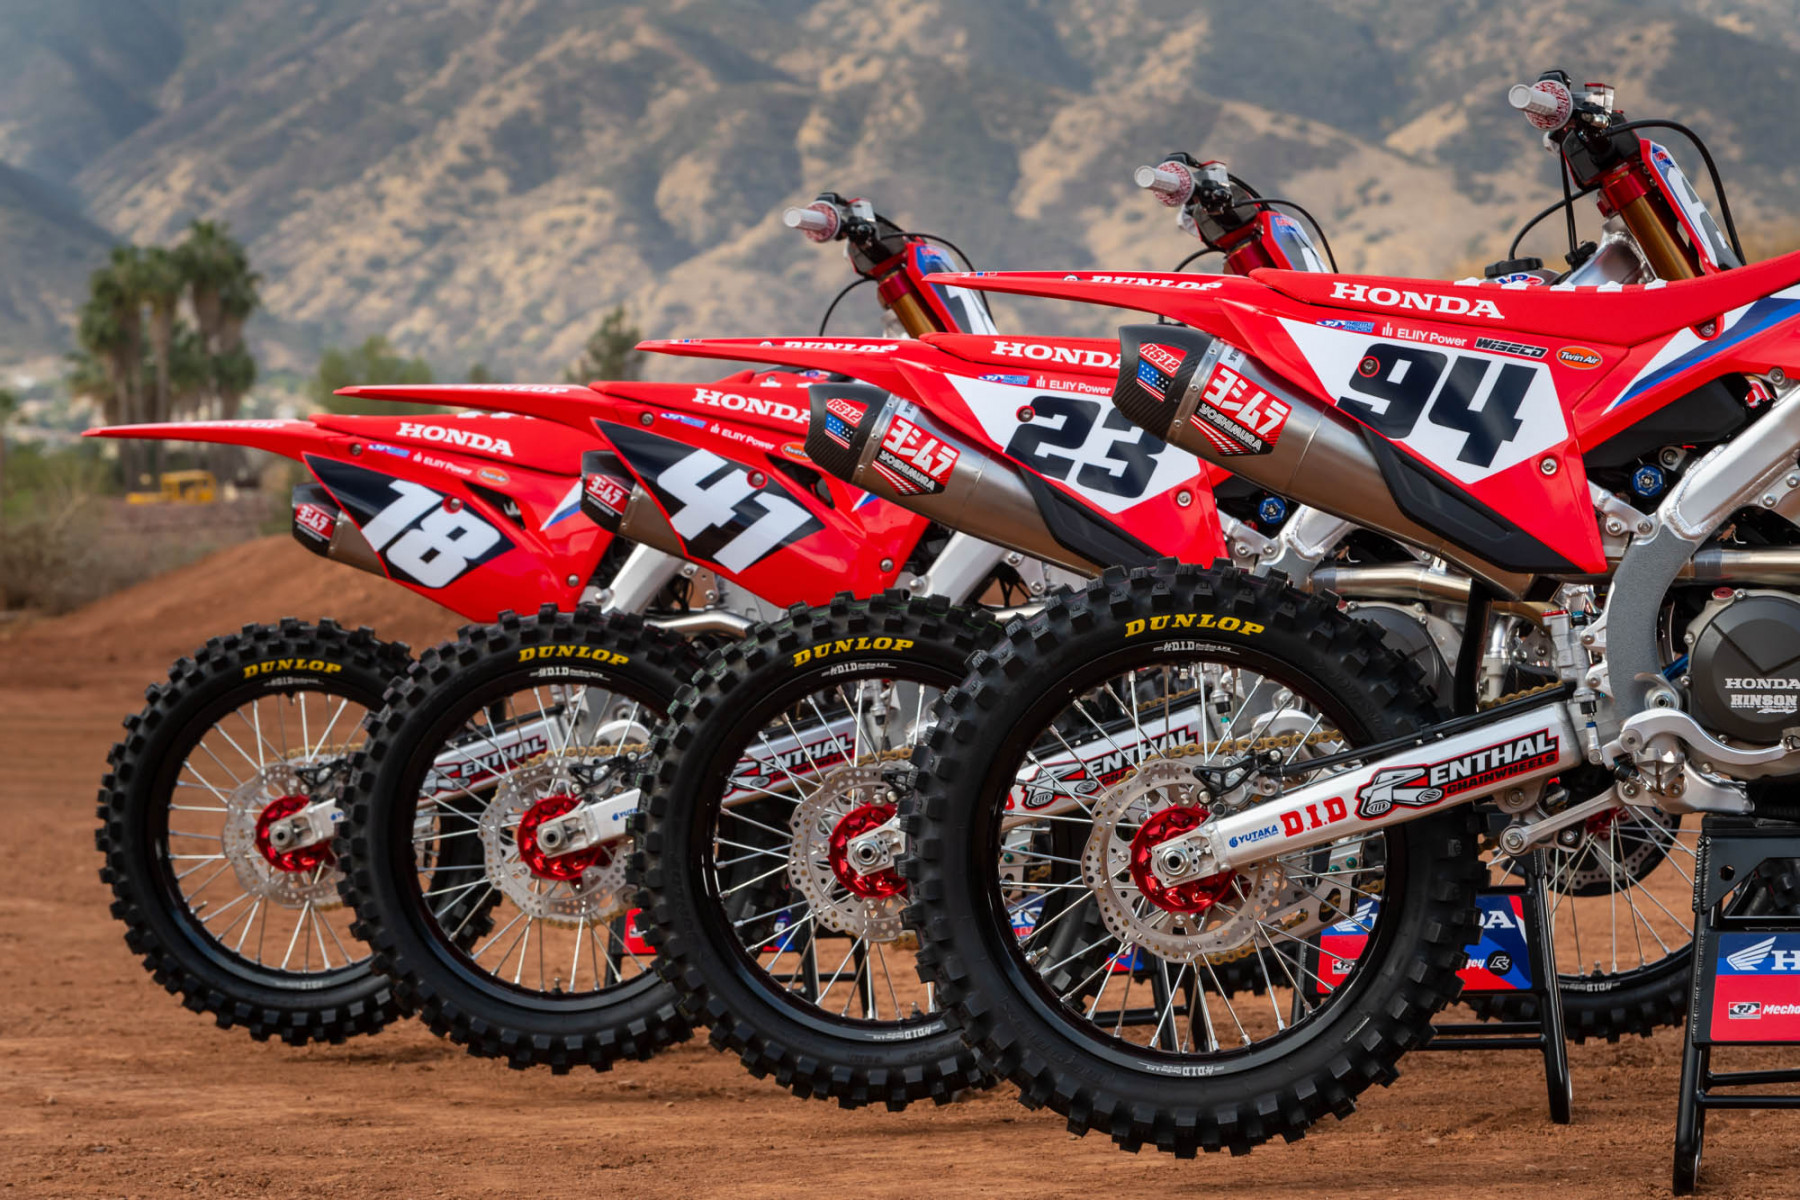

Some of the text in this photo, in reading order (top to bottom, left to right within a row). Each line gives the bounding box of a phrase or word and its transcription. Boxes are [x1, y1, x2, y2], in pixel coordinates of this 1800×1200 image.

[1330, 281, 1505, 320] HONDA
[1430, 332, 1468, 347] Power
[1561, 351, 1584, 363] Twin
[1078, 382, 1112, 395] Power
[1203, 367, 1290, 436] ヨシムラ
[1336, 342, 1537, 468] 94
[396, 422, 514, 457] HONDA
[745, 435, 776, 451] Power
[1199, 402, 1264, 453] YOSHIMURA
[882, 418, 958, 478] ヨシムラ
[1004, 395, 1168, 499] 23
[657, 448, 813, 575] 41
[360, 479, 502, 588] 18
[1124, 613, 1265, 638] DUNLOP
[243, 658, 343, 679] DUNLOP
[518, 644, 630, 666] DUNLOP
[793, 637, 915, 668] DUNLOP
[1725, 678, 1800, 690] HONDA
[1731, 694, 1798, 706] HINSON
[1359, 733, 1556, 817] RENTHAL
[1447, 753, 1557, 794] CHAINWHEELS
[1238, 796, 1348, 843] YUTAKA D.I.D
